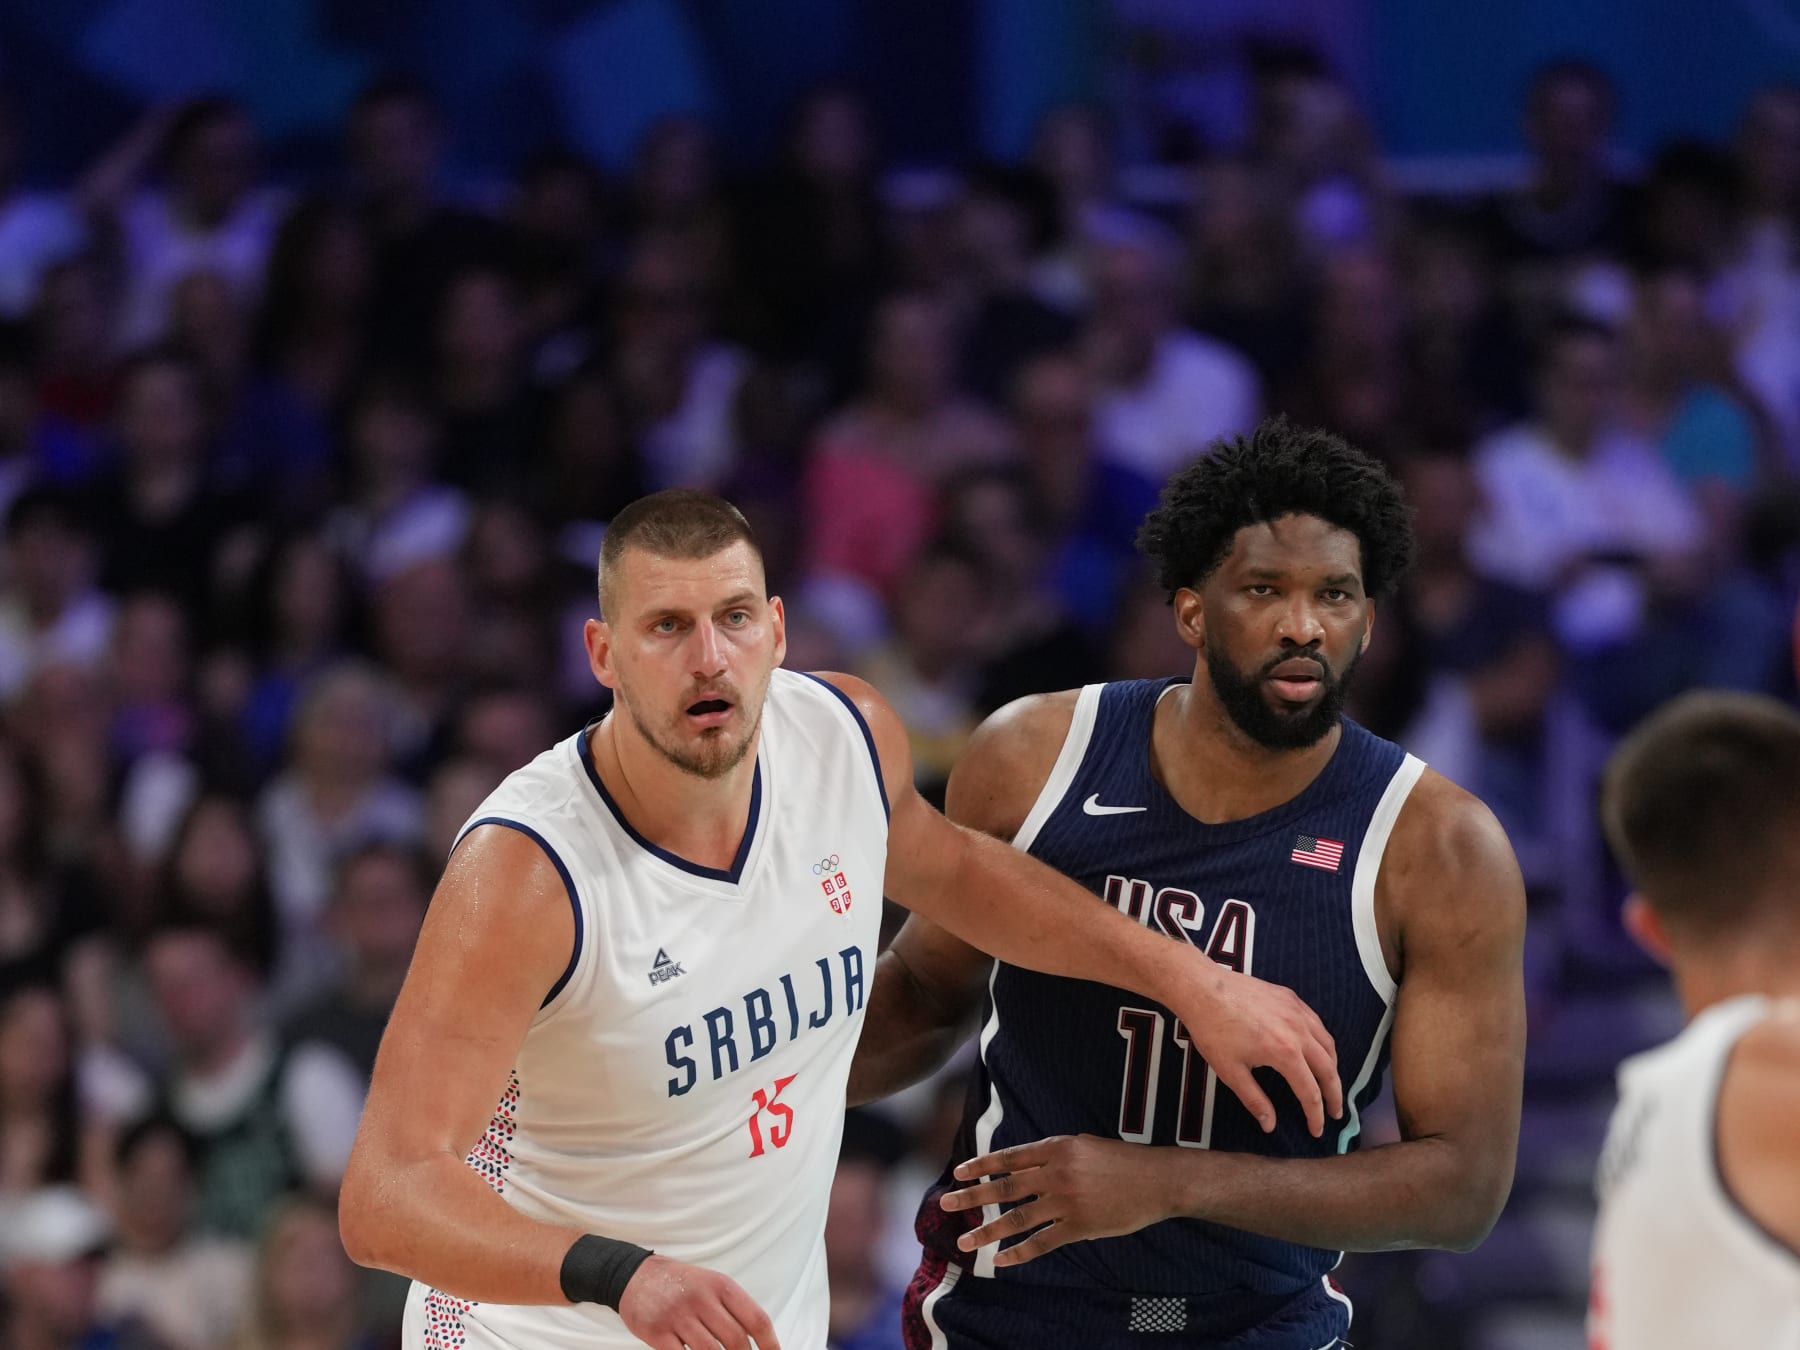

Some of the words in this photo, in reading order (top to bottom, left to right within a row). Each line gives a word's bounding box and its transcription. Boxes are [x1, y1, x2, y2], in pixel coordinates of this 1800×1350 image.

[648, 961, 687, 986] PEAK
[664, 945, 864, 1098] SRBIJA
[749, 1072, 798, 1158] 15
[1117, 1006, 1216, 1150] 11
